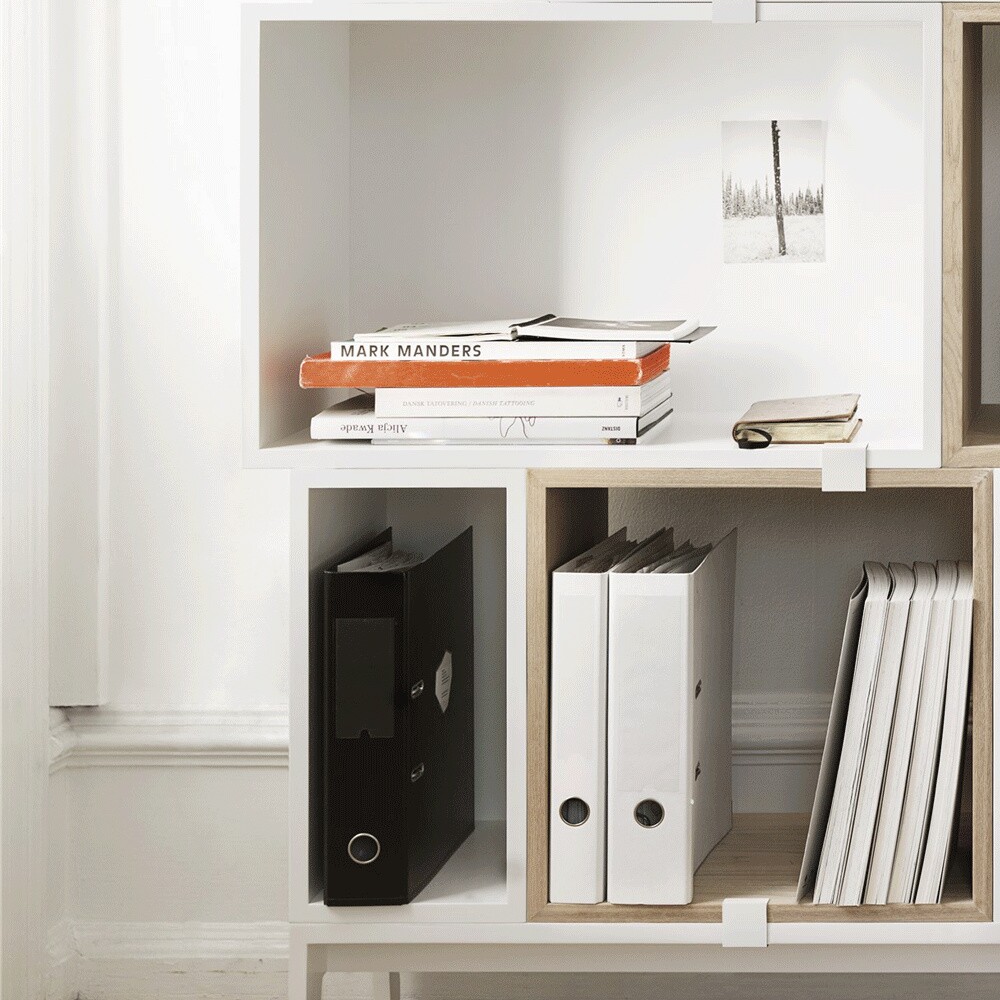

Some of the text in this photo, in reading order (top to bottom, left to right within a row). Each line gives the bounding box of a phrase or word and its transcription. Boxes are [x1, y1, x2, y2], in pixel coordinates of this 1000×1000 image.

[341, 345, 482, 357] MARK MANDERS
[340, 424, 408, 433] Alicja Kwade
